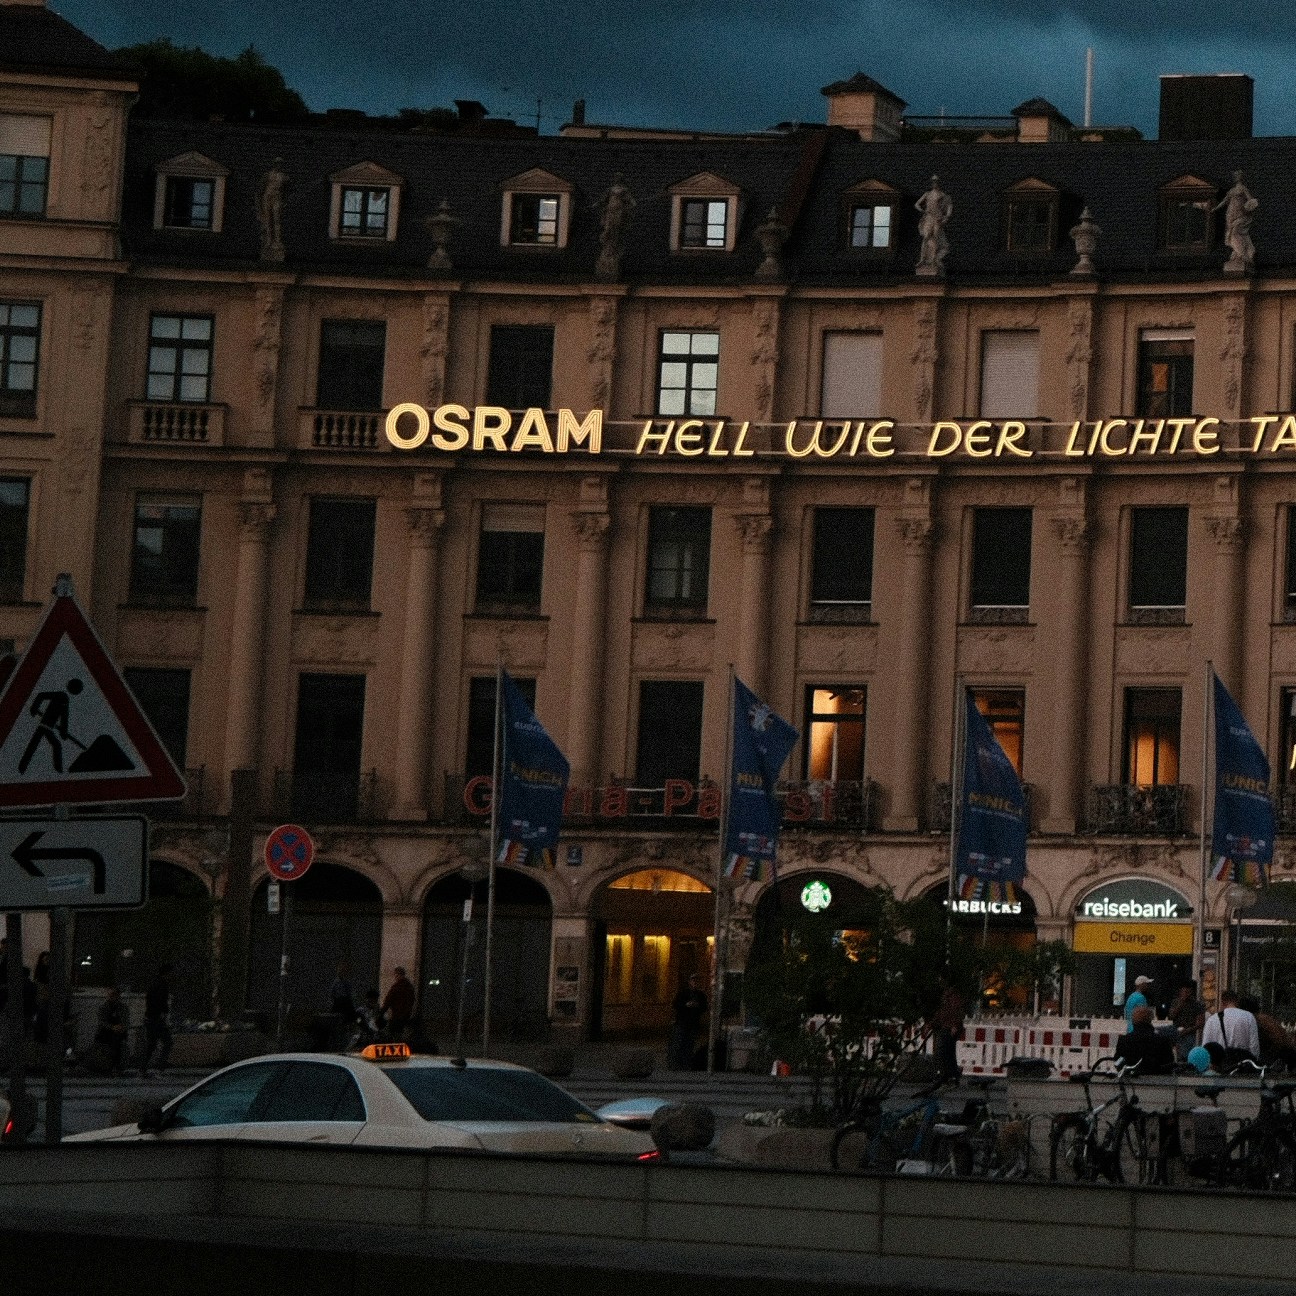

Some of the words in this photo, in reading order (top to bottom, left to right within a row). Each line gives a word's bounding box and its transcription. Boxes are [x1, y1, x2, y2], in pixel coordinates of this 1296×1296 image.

[385, 402, 603, 454] OSRAM
[636, 420, 755, 456] HELL
[785, 420, 896, 457] WIE
[927, 421, 1033, 457] DER
[1065, 418, 1220, 457] LICHTE
[942, 900, 1022, 914] ARBUCKS
[1110, 930, 1156, 945] Change
[1205, 931, 1213, 944] 8
[376, 1044, 406, 1057] TAXI
